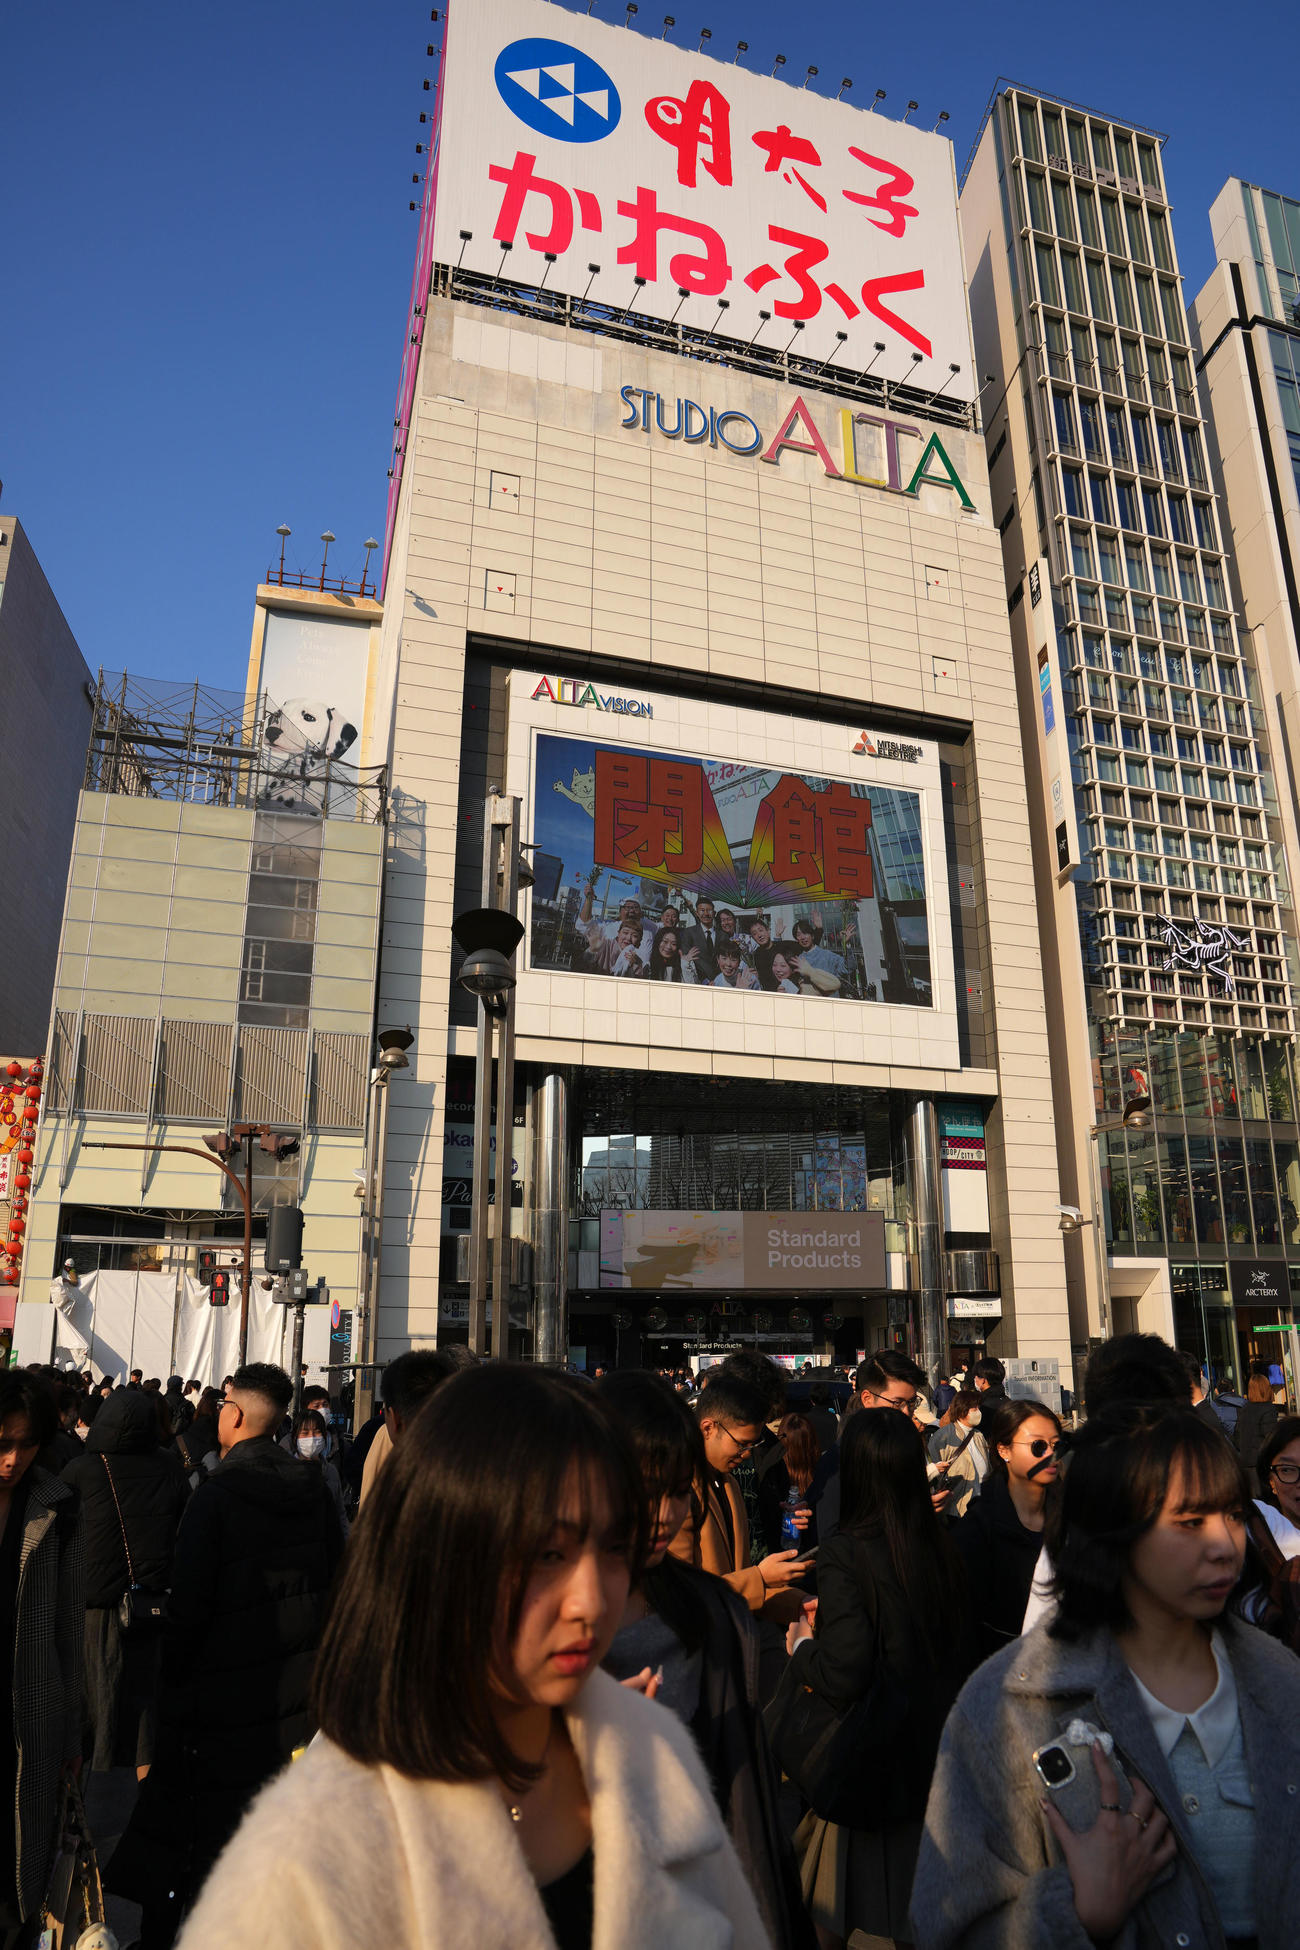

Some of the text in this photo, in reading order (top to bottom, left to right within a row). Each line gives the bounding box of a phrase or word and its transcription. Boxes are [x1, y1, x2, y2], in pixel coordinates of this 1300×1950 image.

[644, 79, 920, 238] 明太子
[488, 151, 933, 359] かねふく
[620, 385, 978, 511] STUDIO ALTA
[599, 694, 653, 719] VISION
[877, 739, 923, 756] MITSUBISHI
[877, 747, 918, 762] ELECTRIC
[594, 748, 874, 899] 閉館
[514, 1116, 525, 1124] 6F
[767, 1229, 861, 1247] Standard
[768, 1250, 861, 1268] Products
